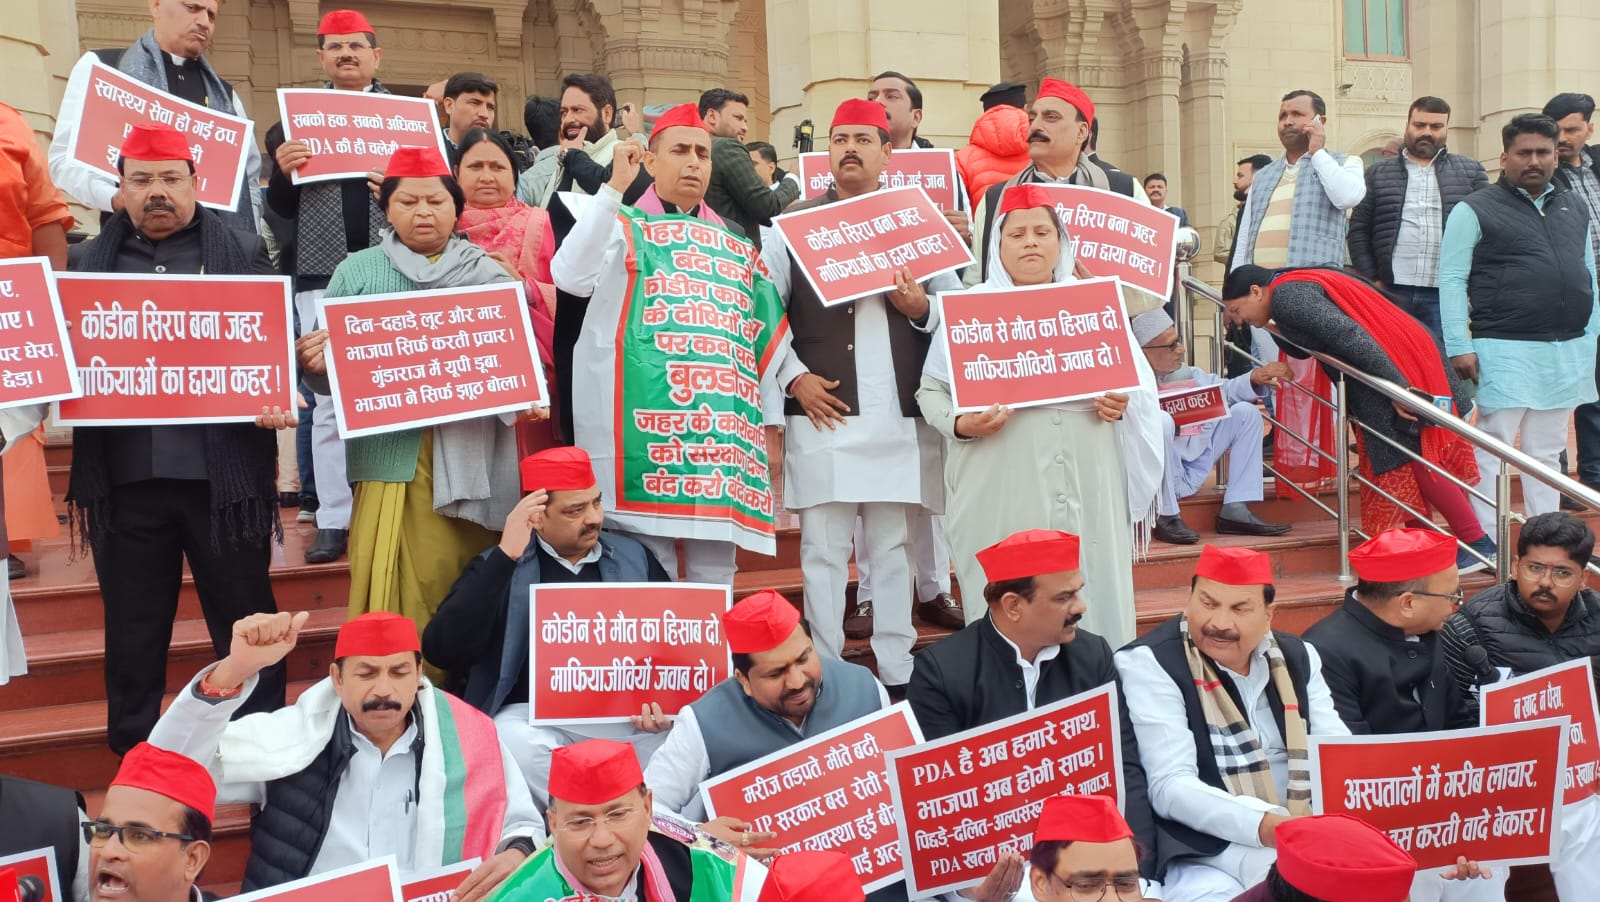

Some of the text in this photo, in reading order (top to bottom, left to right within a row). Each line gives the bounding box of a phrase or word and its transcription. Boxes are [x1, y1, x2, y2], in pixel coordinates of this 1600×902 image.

[95, 77, 147, 115] स्वास्थ्य
[149, 100, 174, 125] सेवा
[175, 111, 191, 132] हो
[292, 110, 325, 128] सबको
[352, 113, 383, 130] सबको
[336, 137, 351, 154] की
[354, 137, 366, 155] ही
[689, 222, 720, 248] का
[804, 225, 846, 251] कोडीन
[839, 221, 875, 244] सिरप
[870, 213, 898, 235] बना
[1075, 203, 1106, 229] सिरप
[1107, 214, 1130, 236] बना
[1081, 240, 1099, 259] का
[673, 246, 712, 274] बंद
[716, 258, 752, 288] करो
[816, 251, 876, 283] माफियाओं
[870, 251, 893, 270] का
[81, 301, 138, 341] कोडीन
[142, 300, 185, 342] सिरप
[189, 311, 221, 341] बना
[420, 311, 444, 331] लूट
[448, 304, 475, 324] और
[643, 299, 669, 325] के
[673, 300, 741, 335] दोषियों
[950, 317, 994, 345] कोडीन
[995, 316, 1009, 344] से
[1010, 314, 1037, 342] मौत
[1038, 316, 1059, 338] का
[1058, 309, 1099, 336] हिसाब
[346, 342, 393, 361] भाजपा
[395, 334, 429, 356] सिर्फ
[431, 331, 471, 350] करती
[656, 333, 689, 353] पर
[692, 334, 731, 357] कब
[161, 365, 184, 396] का
[370, 364, 426, 388] गुंडाराज
[428, 358, 442, 376] में
[444, 356, 471, 378] यूपी
[963, 347, 1058, 382] माफियाजीवियों
[1058, 348, 1095, 373] जवाब
[355, 393, 402, 413] भाजपा
[404, 388, 418, 406] ने
[419, 384, 454, 405] सिर्फ
[634, 409, 687, 434] जहर
[690, 403, 713, 433] के
[648, 437, 683, 464] को
[686, 438, 746, 471] संरक्षण
[643, 469, 679, 495] बंद
[682, 472, 723, 497] करो
[745, 487, 774, 514] करो
[541, 611, 591, 645] कोडीन
[593, 611, 607, 646] से
[610, 610, 638, 645] मौत
[640, 618, 661, 644] का
[663, 609, 703, 646] हिसाब
[550, 656, 653, 693] माफियाजीवियों
[654, 665, 692, 692] जवाब
[912, 759, 955, 787] PDA
[958, 745, 974, 775] है
[978, 739, 1009, 768] अब
[1011, 720, 1058, 758] हमारे
[741, 774, 782, 804] मरीज
[774, 797, 826, 832] सरकार
[824, 787, 849, 811] बस
[850, 770, 884, 801] रोती
[916, 786, 980, 821] भाजपा
[983, 775, 1013, 803] अब
[1015, 759, 1056, 794] होगी
[1344, 764, 1424, 811] अस्पतालों
[1425, 763, 1442, 800] में
[1443, 760, 1485, 799] गरीब
[854, 808, 878, 840] हुई
[1415, 811, 1461, 849] करती
[1462, 807, 1492, 842] वादे
[930, 856, 962, 877] PDA
[962, 845, 998, 870] खत्म
